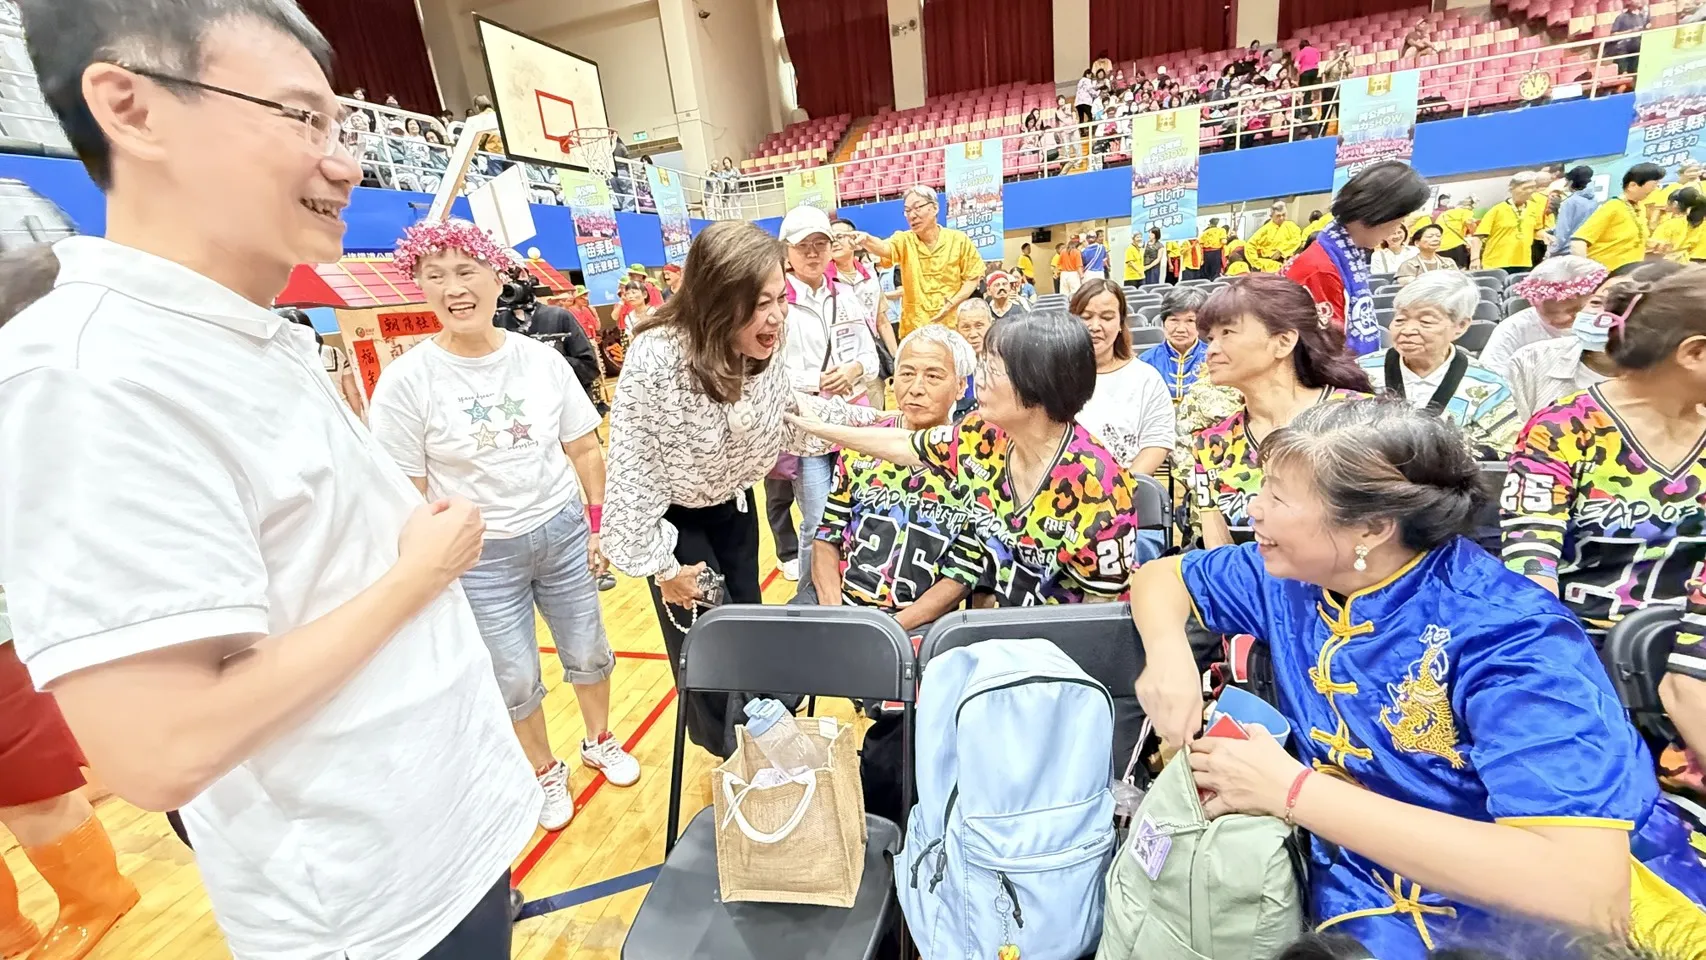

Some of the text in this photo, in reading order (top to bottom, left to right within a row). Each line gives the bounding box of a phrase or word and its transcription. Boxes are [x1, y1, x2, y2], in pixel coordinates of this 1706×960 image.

[1644, 113, 1705, 142] 苗栗縣
[1143, 186, 1186, 207] 臺北市
[956, 209, 993, 229] 臺北市
[1500, 472, 1555, 512] 25
[842, 513, 950, 607] 25
